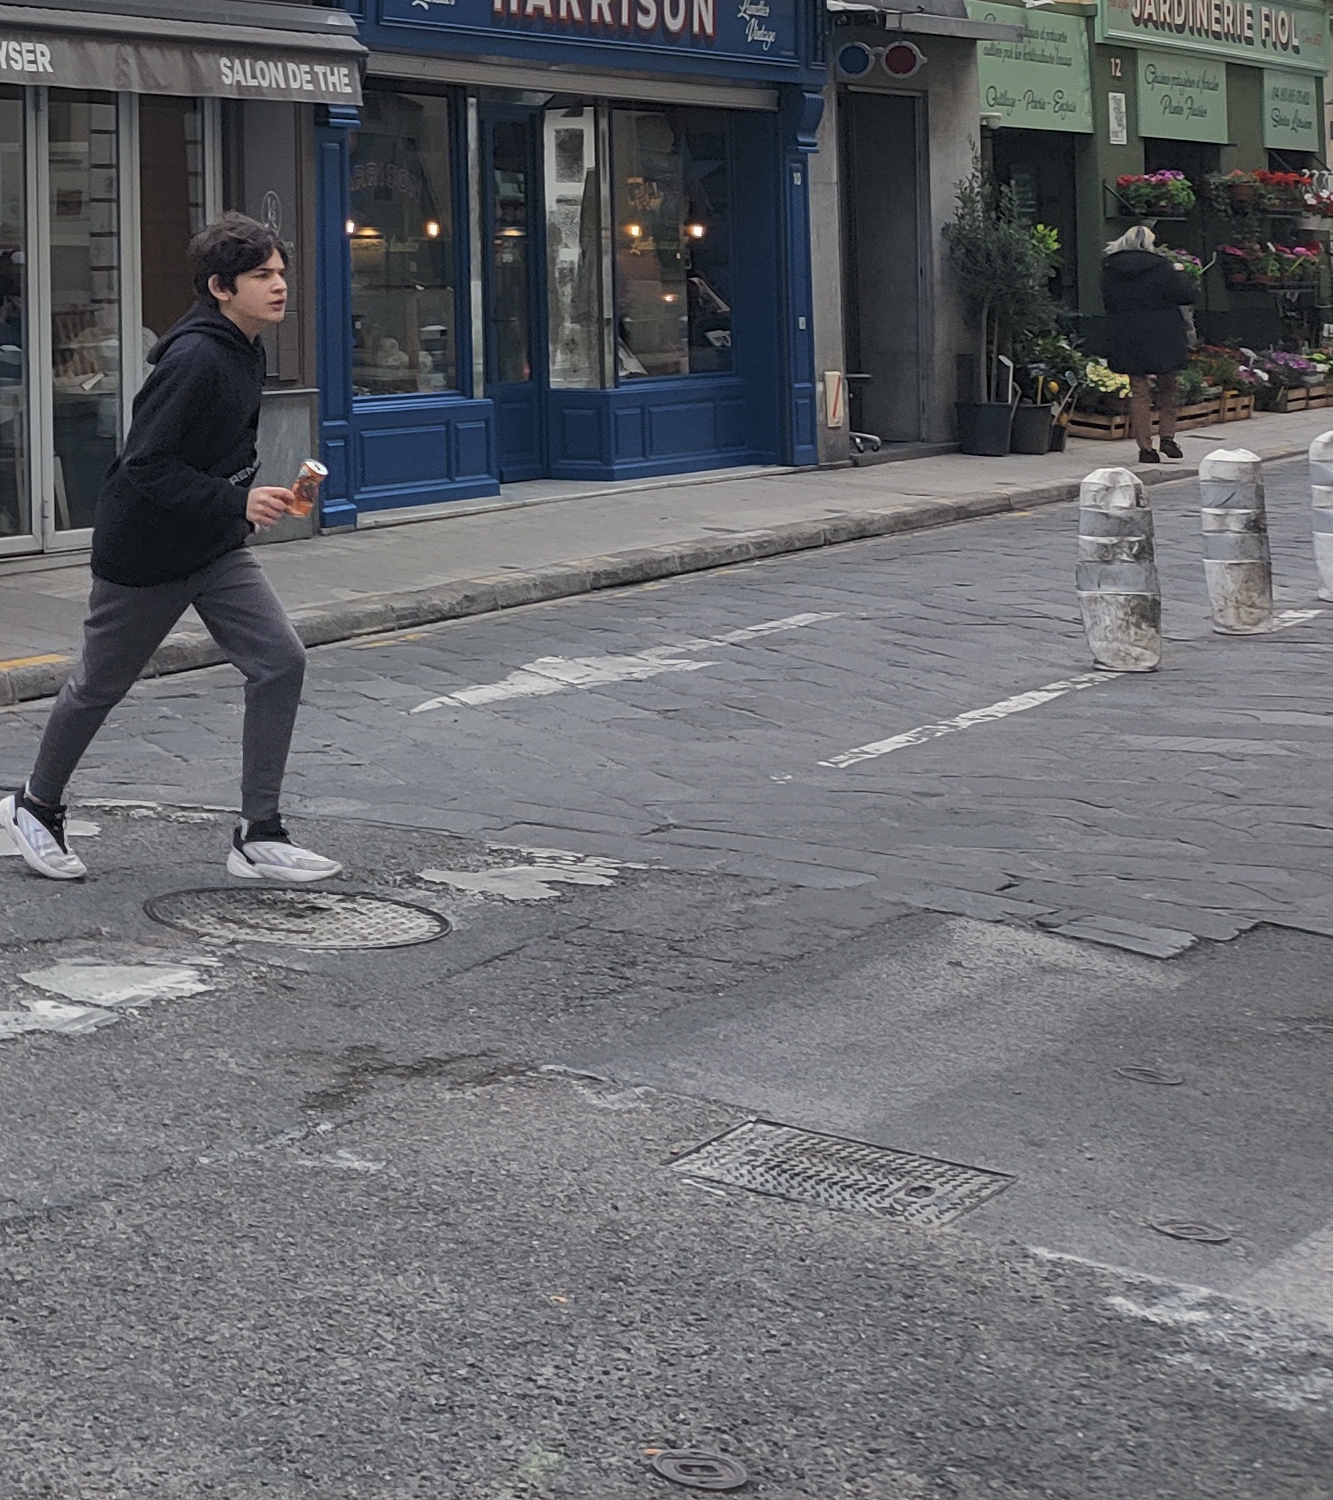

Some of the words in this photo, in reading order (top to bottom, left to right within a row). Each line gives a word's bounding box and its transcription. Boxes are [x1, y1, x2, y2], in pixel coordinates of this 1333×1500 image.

[1261, 6, 1300, 46] FIOL
[219, 57, 286, 89] SALON
[287, 63, 311, 91] DE
[314, 65, 353, 93] THE
[1110, 58, 1122, 77] 12
[793, 172, 802, 185] 10
